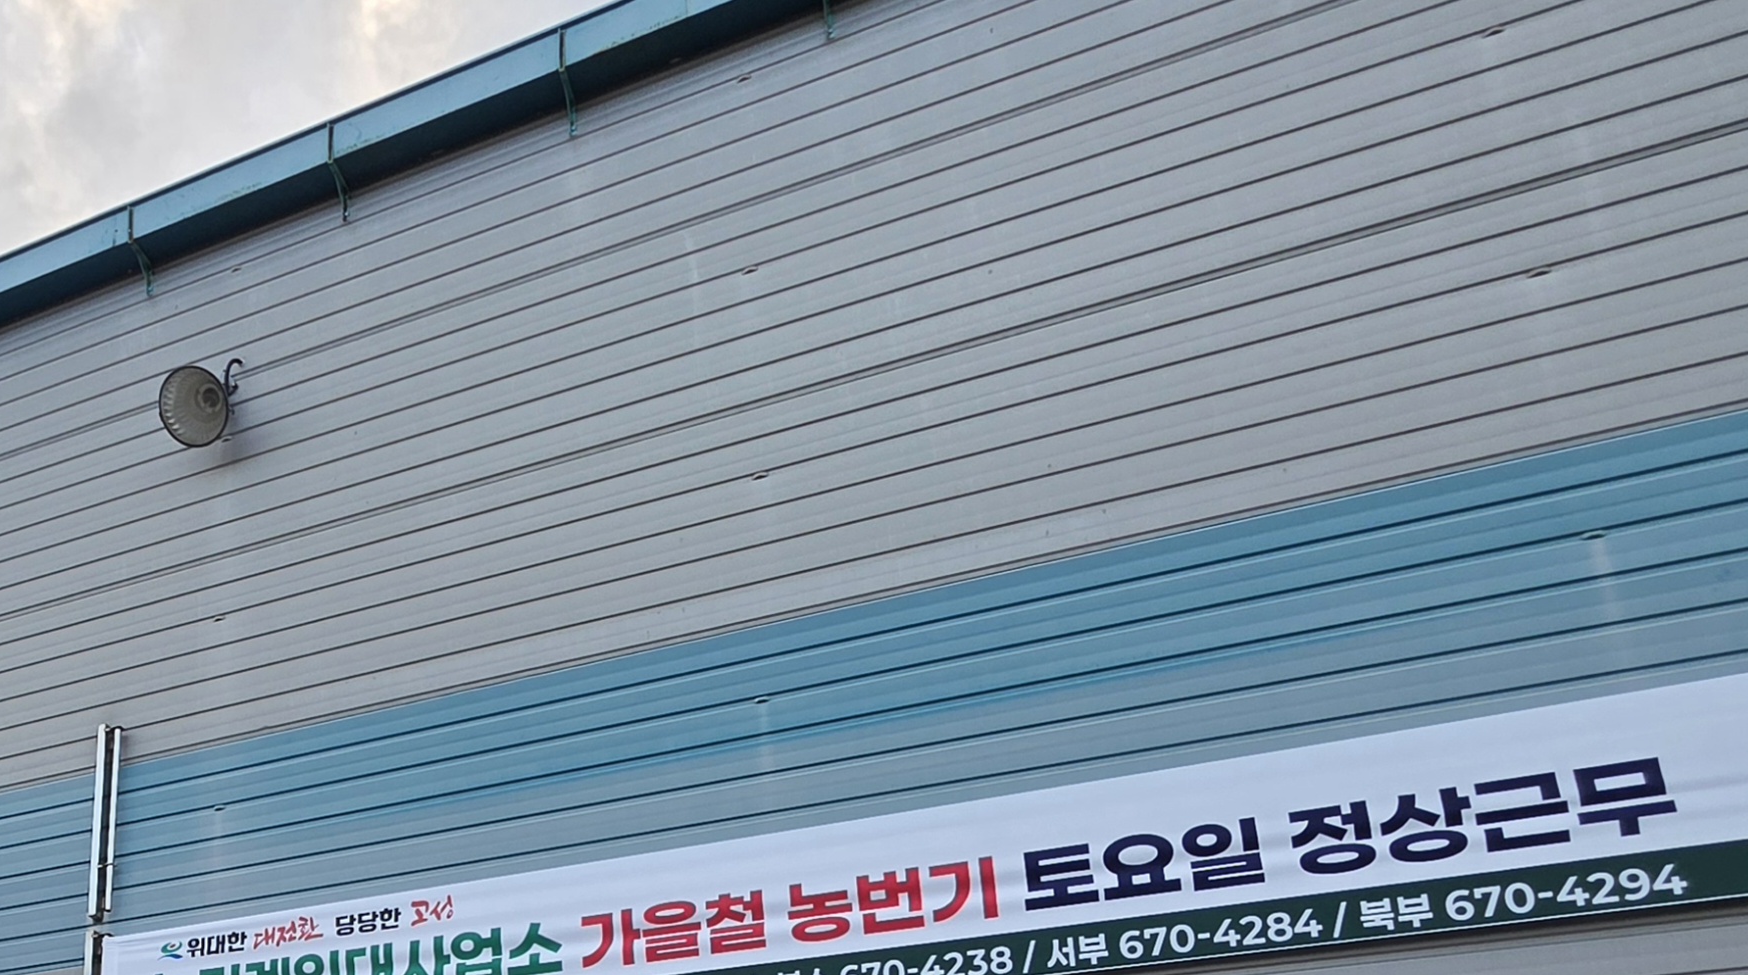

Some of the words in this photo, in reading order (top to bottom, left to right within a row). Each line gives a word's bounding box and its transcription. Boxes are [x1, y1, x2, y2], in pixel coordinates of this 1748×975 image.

[581, 890, 767, 968] 가을철
[788, 856, 1000, 943] 농번기
[1023, 817, 1266, 911] 토요일
[1288, 757, 1678, 875] 정상근무
[186, 931, 248, 958] 위대한
[252, 916, 324, 951] 대전환
[335, 907, 402, 936] 당당한
[410, 894, 455, 925] 고성
[1047, 933, 1109, 969] 서부
[1118, 907, 1323, 960] 670-4284
[1359, 893, 1434, 931] 북부
[1444, 864, 1688, 923] 670-4294
